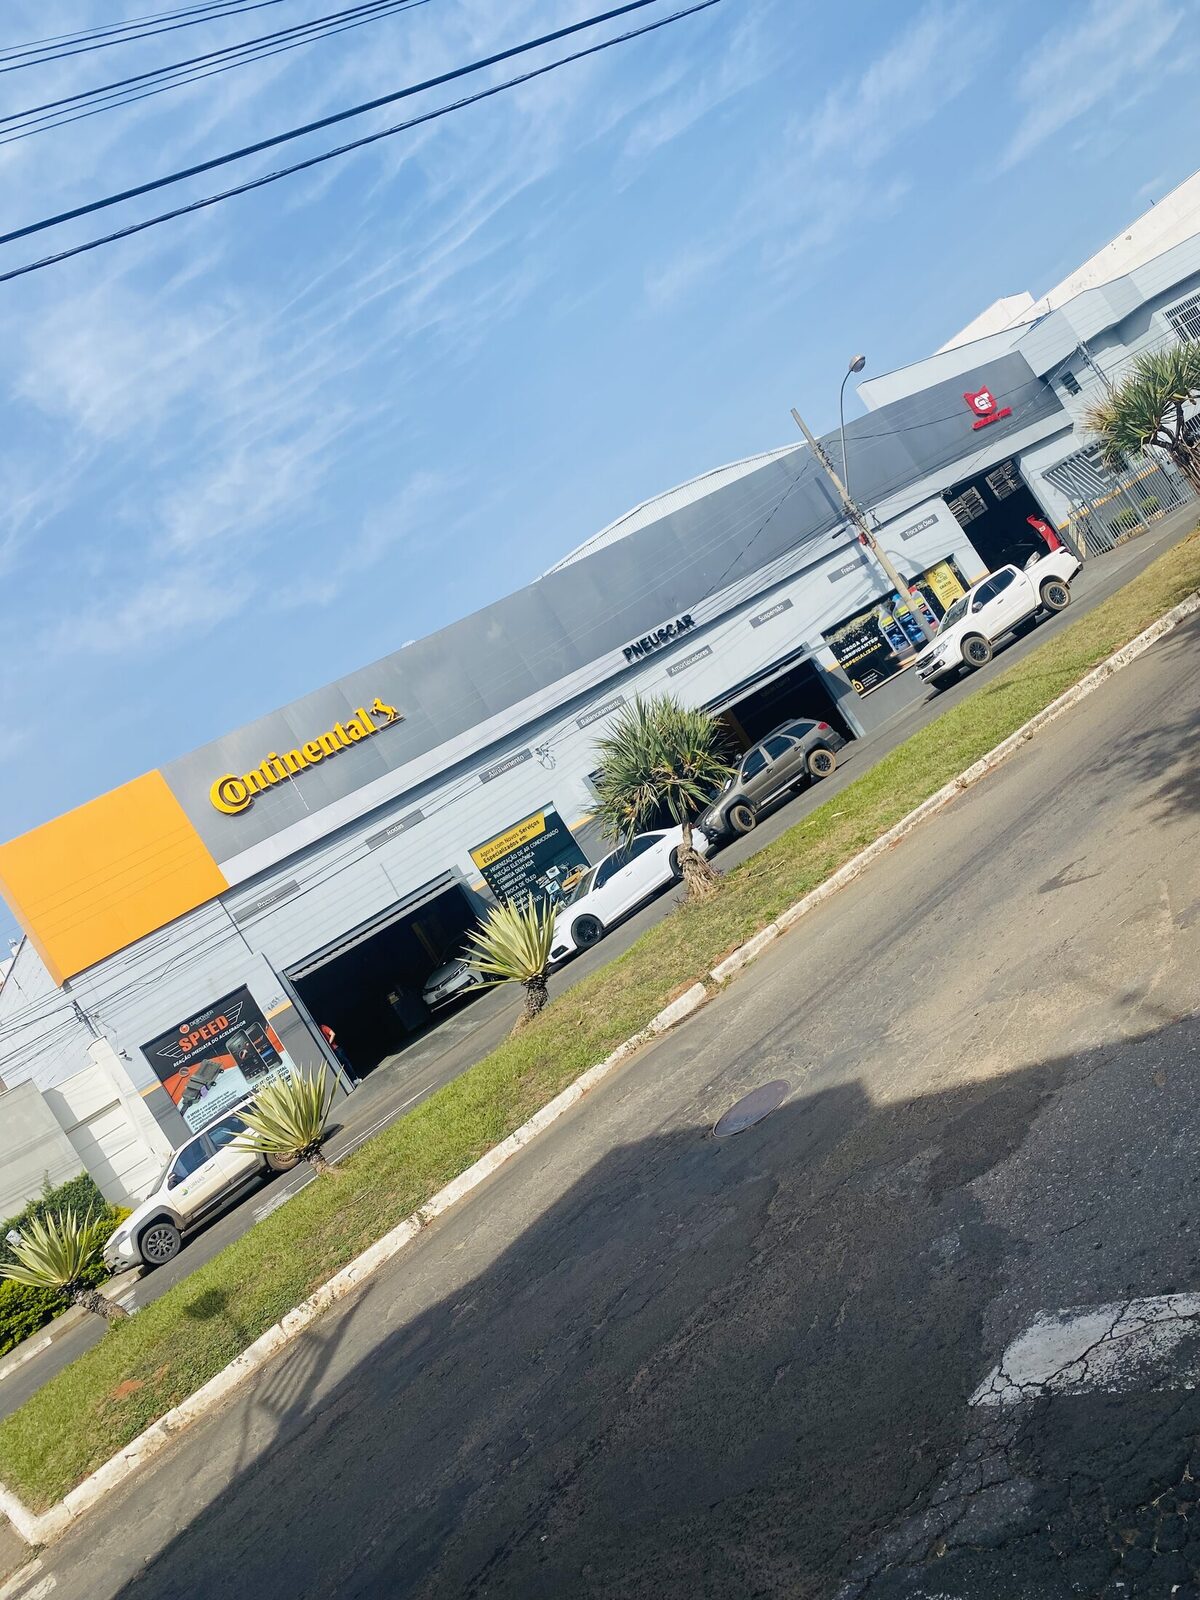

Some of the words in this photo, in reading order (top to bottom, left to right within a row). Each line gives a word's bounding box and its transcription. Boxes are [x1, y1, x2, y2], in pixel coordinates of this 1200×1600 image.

[905, 527, 917, 537] Troca
[923, 518, 933, 526] Óleo
[840, 565, 855, 574] Freios
[758, 604, 783, 621] Suspensão
[622, 614, 695, 661] PNEUSCAR
[842, 642, 860, 654] TROCA
[671, 649, 708, 673] Amortecedores
[838, 638, 878, 663] LUBRIFICANTES
[842, 643, 881, 669] ESPECIALIZADA
[209, 707, 377, 813] Continental
[488, 755, 525, 778] Alinhamento
[386, 823, 404, 835] Rodas
[480, 847, 494, 857] Agora
[494, 840, 504, 849] com
[503, 831, 518, 843] Novos
[519, 820, 539, 834] Serviços
[483, 840, 518, 863] Especializados
[490, 853, 517, 872] HIGIENIZAÇÃO
[529, 828, 559, 848] CONDICIONADO
[493, 865, 510, 878] INJEÇÃO
[509, 852, 534, 868] ELETRÔNICA
[496, 871, 515, 884] CORREIA
[515, 860, 534, 873] DENTADA
[500, 872, 526, 890] EMBREAGEM
[524, 873, 536, 883] ÓLEO
[173, 1053, 191, 1067] REAÇÃO
[192, 1042, 211, 1056] IMEDIATA
[211, 1036, 219, 1044] DO
[219, 1020, 246, 1039] ACELERADOR
[178, 1015, 229, 1052] SPEED
